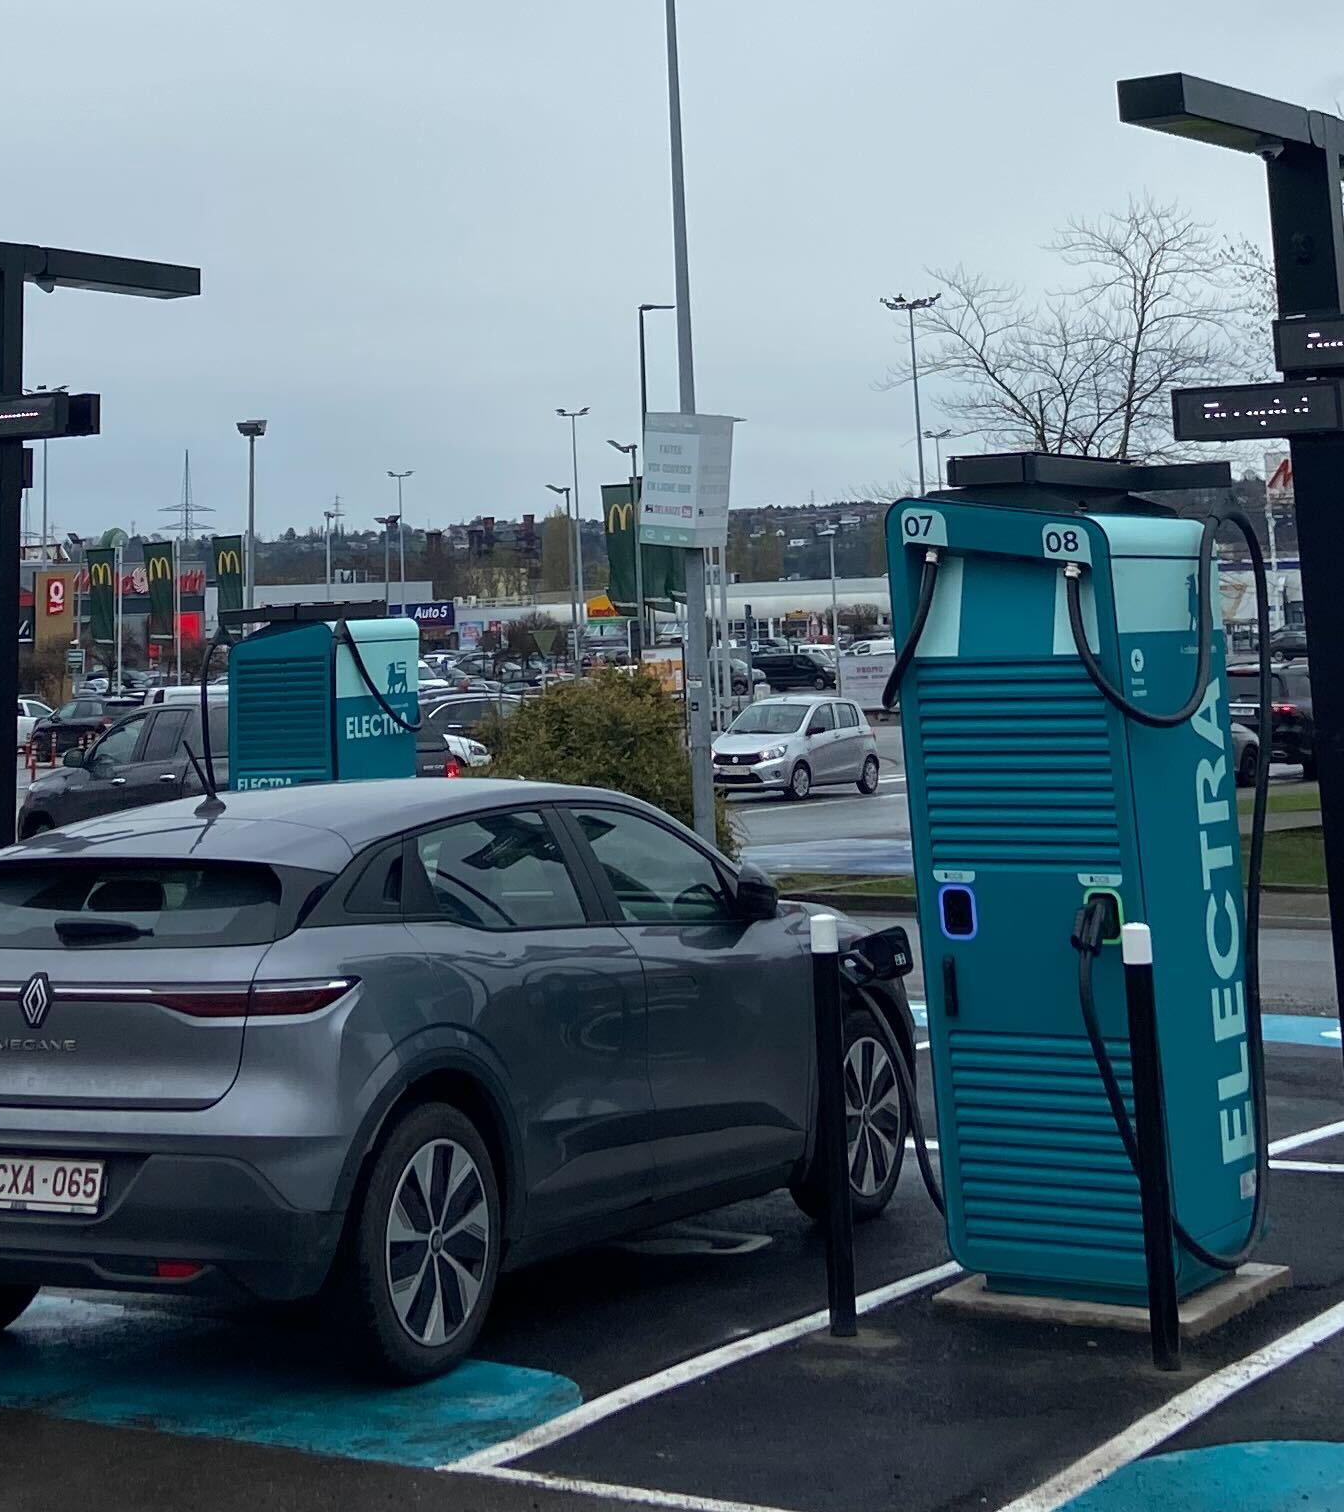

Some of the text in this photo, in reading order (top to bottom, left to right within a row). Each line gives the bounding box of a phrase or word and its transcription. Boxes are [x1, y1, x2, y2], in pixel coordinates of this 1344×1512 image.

[904, 515, 933, 537] 07
[1045, 530, 1079, 553] 08
[1191, 677, 1256, 1165] ELECTRA
